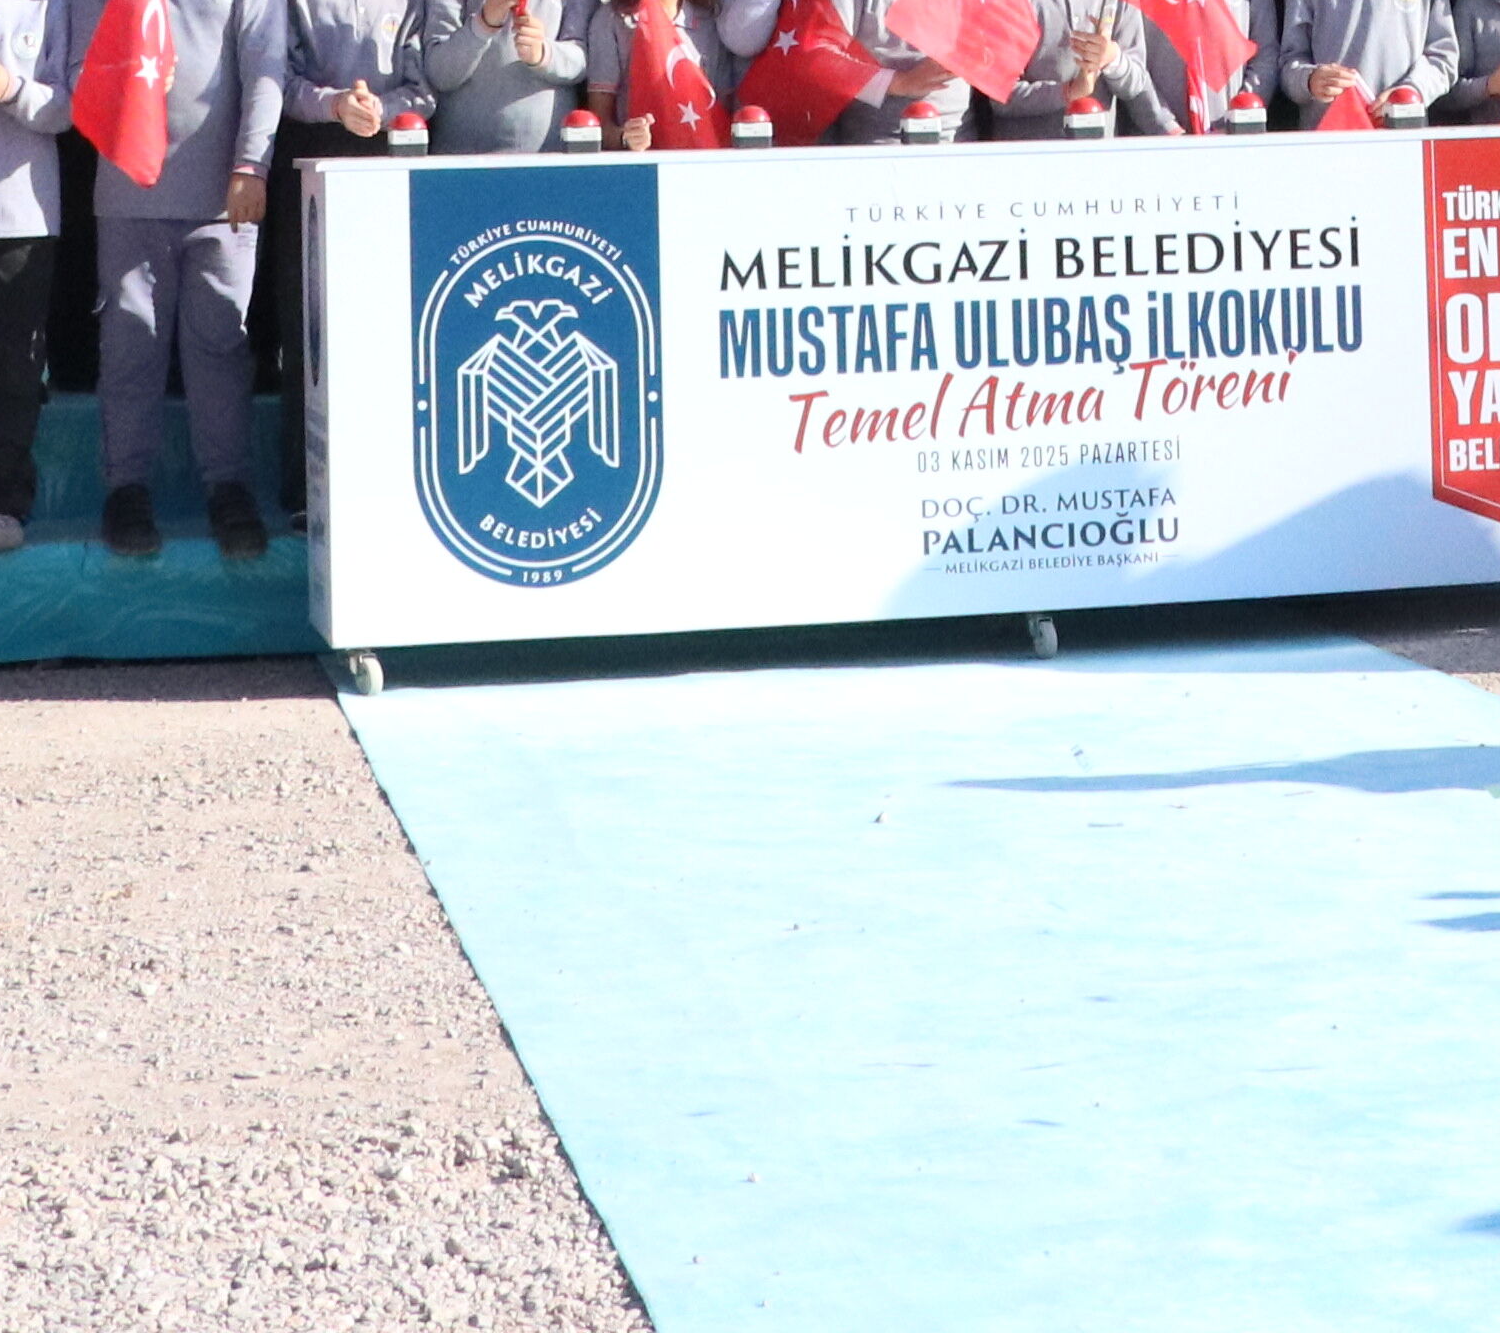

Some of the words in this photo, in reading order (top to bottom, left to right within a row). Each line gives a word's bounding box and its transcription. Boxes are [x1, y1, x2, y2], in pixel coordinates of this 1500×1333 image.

[845, 200, 987, 223] TÜRKİYE
[1009, 190, 1239, 219] CUMHURİYETİ
[449, 222, 512, 266] TÜRKİYE
[515, 219, 624, 262] CUMHURİYETİ
[719, 227, 1029, 291] MELİKGAZİ
[1054, 215, 1360, 279] BELEDİYESİ
[1442, 226, 1499, 278] EN
[463, 251, 614, 309] MELİKGAZİ
[718, 301, 939, 379] MUSTAFA
[953, 293, 1132, 375] ULUBAŞ
[1147, 284, 1363, 361] İLKOKULU
[788, 372, 955, 454] Temel
[958, 374, 1103, 438] Atma
[1129, 349, 1298, 421] Töreni
[917, 450, 941, 473] 03
[951, 447, 1010, 471] KASIM
[1021, 444, 1069, 469] 2025
[1080, 434, 1182, 465] PAZARTESİ
[921, 496, 992, 523] DOÇ.
[1001, 494, 1048, 515] DR.
[1056, 487, 1177, 512] MUSTAFA
[478, 507, 603, 550] BELEDİYESİ
[923, 510, 1180, 556] PALANCIOĞLU
[522, 569, 563, 583] 1989
[945, 558, 1024, 574] MELİKGAZİ
[1028, 554, 1093, 571] BELEDİYE
[1097, 551, 1160, 569] BAŞKANI
